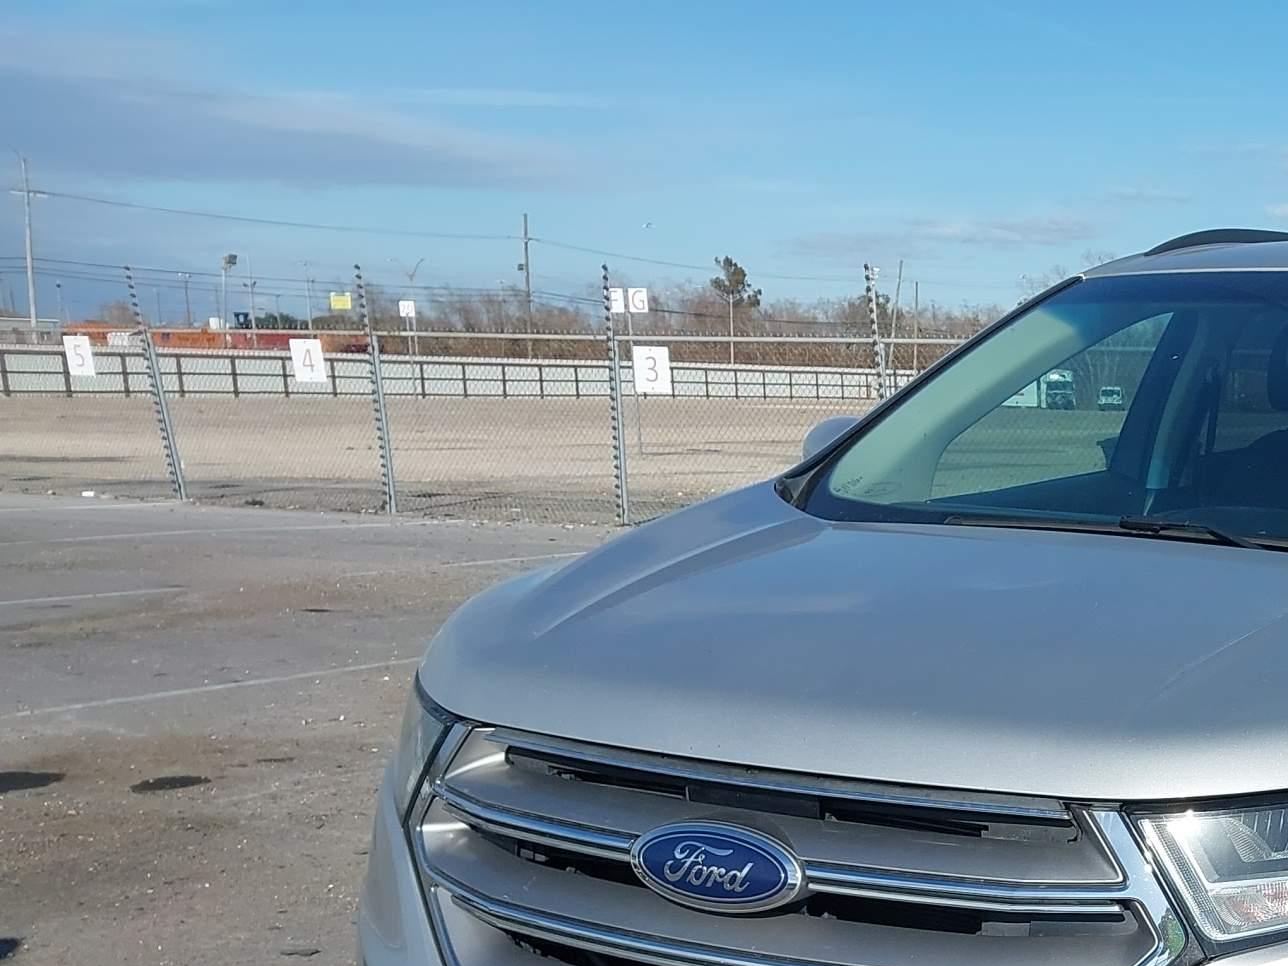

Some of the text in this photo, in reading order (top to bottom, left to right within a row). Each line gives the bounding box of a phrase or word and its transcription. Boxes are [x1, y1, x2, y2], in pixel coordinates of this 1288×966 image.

[632, 290, 645, 310] G
[72, 343, 85, 368] 5
[302, 347, 316, 373] 4
[645, 356, 658, 382] 3
[664, 841, 753, 892] Ford
